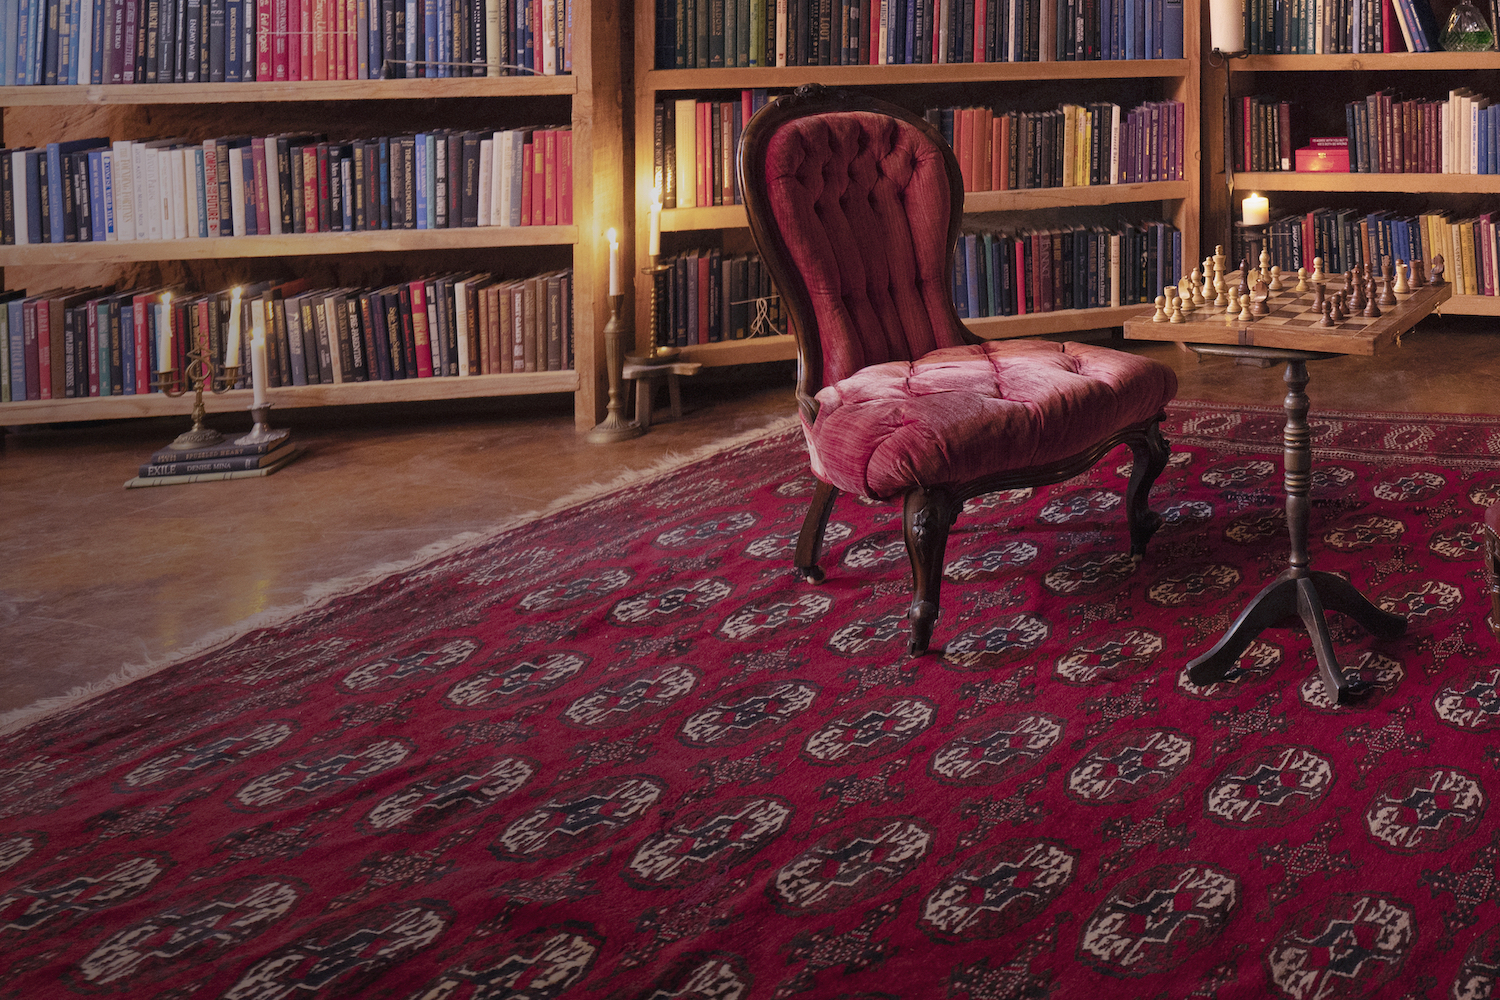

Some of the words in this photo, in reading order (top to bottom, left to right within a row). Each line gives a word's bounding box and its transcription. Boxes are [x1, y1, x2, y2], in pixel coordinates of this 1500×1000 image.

[260, 13, 269, 26] Evil
[820, 18, 830, 42] LOOT
[259, 28, 269, 54] Angels
[206, 152, 216, 186] COMPETING
[208, 196, 218, 221] FUTURE
[350, 315, 361, 368] PRE-PARENTING
